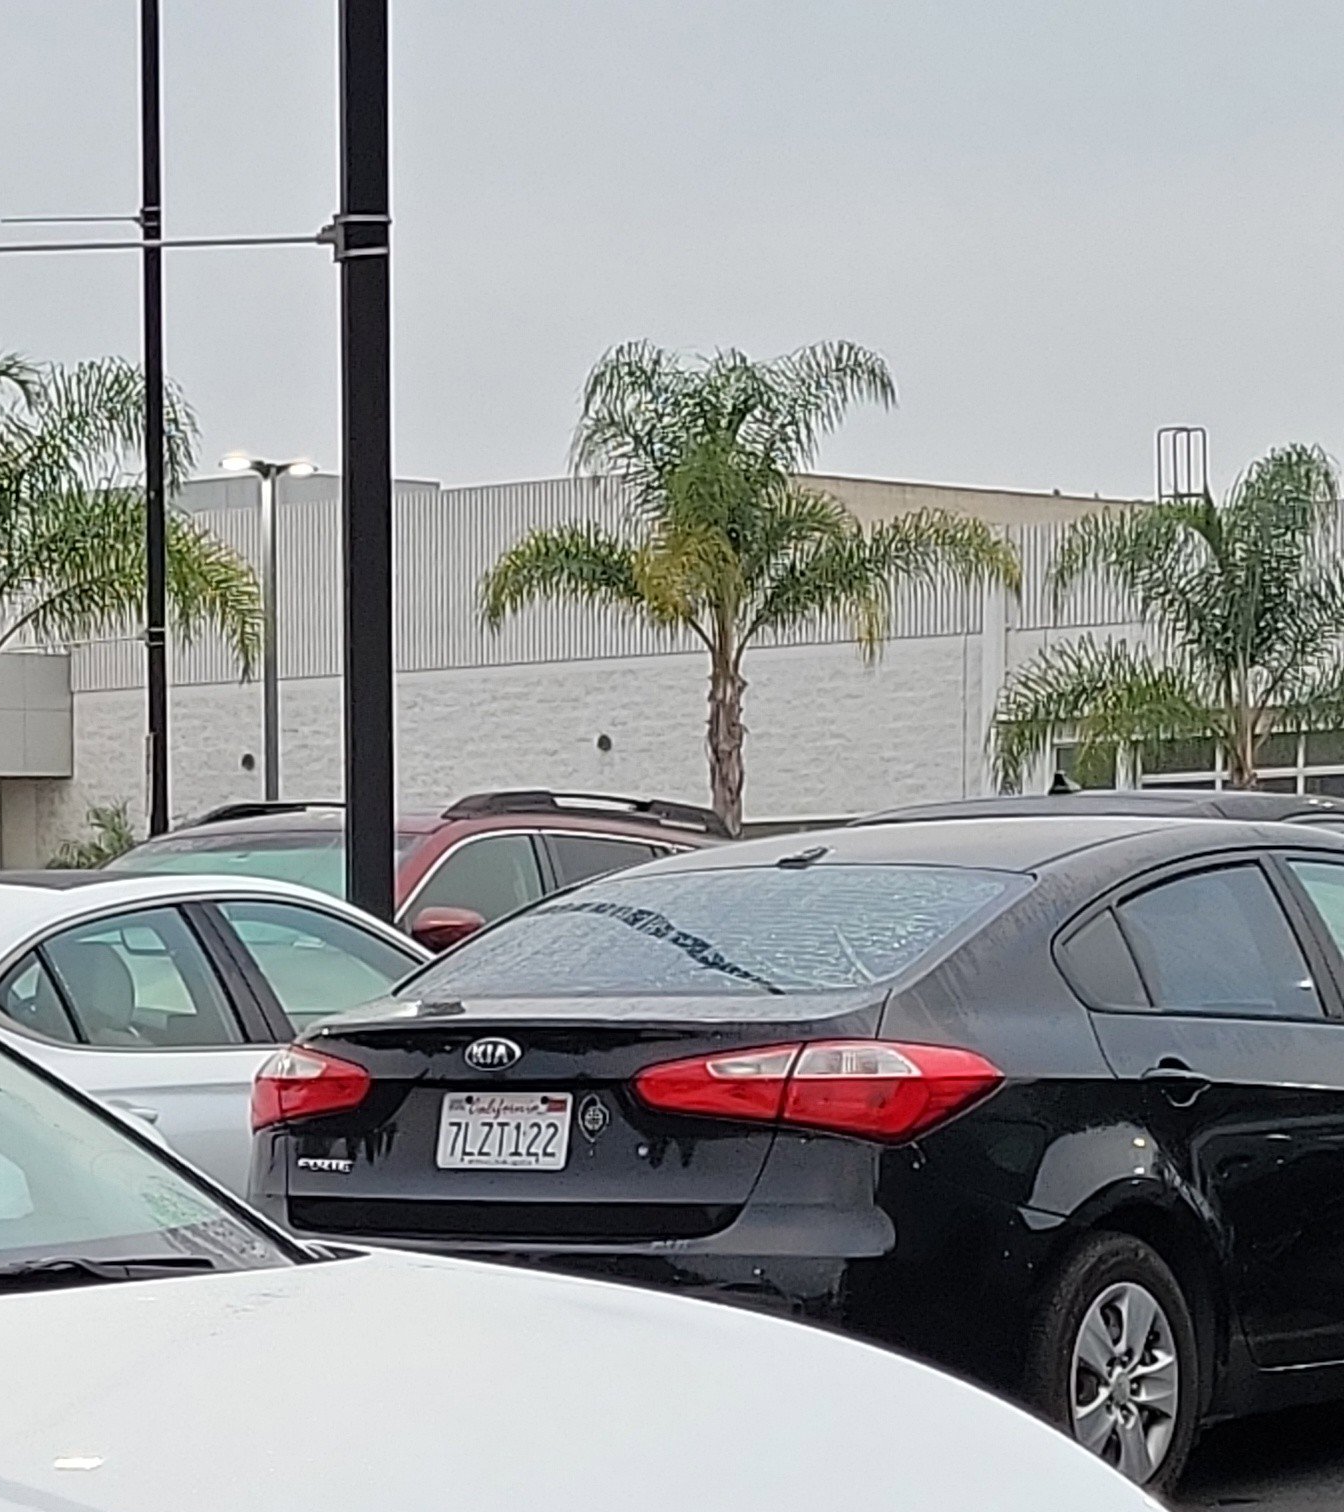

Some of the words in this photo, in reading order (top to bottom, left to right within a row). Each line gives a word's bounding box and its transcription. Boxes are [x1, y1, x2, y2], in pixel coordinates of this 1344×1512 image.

[472, 1043, 509, 1065] KIA
[468, 1097, 545, 1119] California
[448, 1121, 560, 1158] 7LZT122
